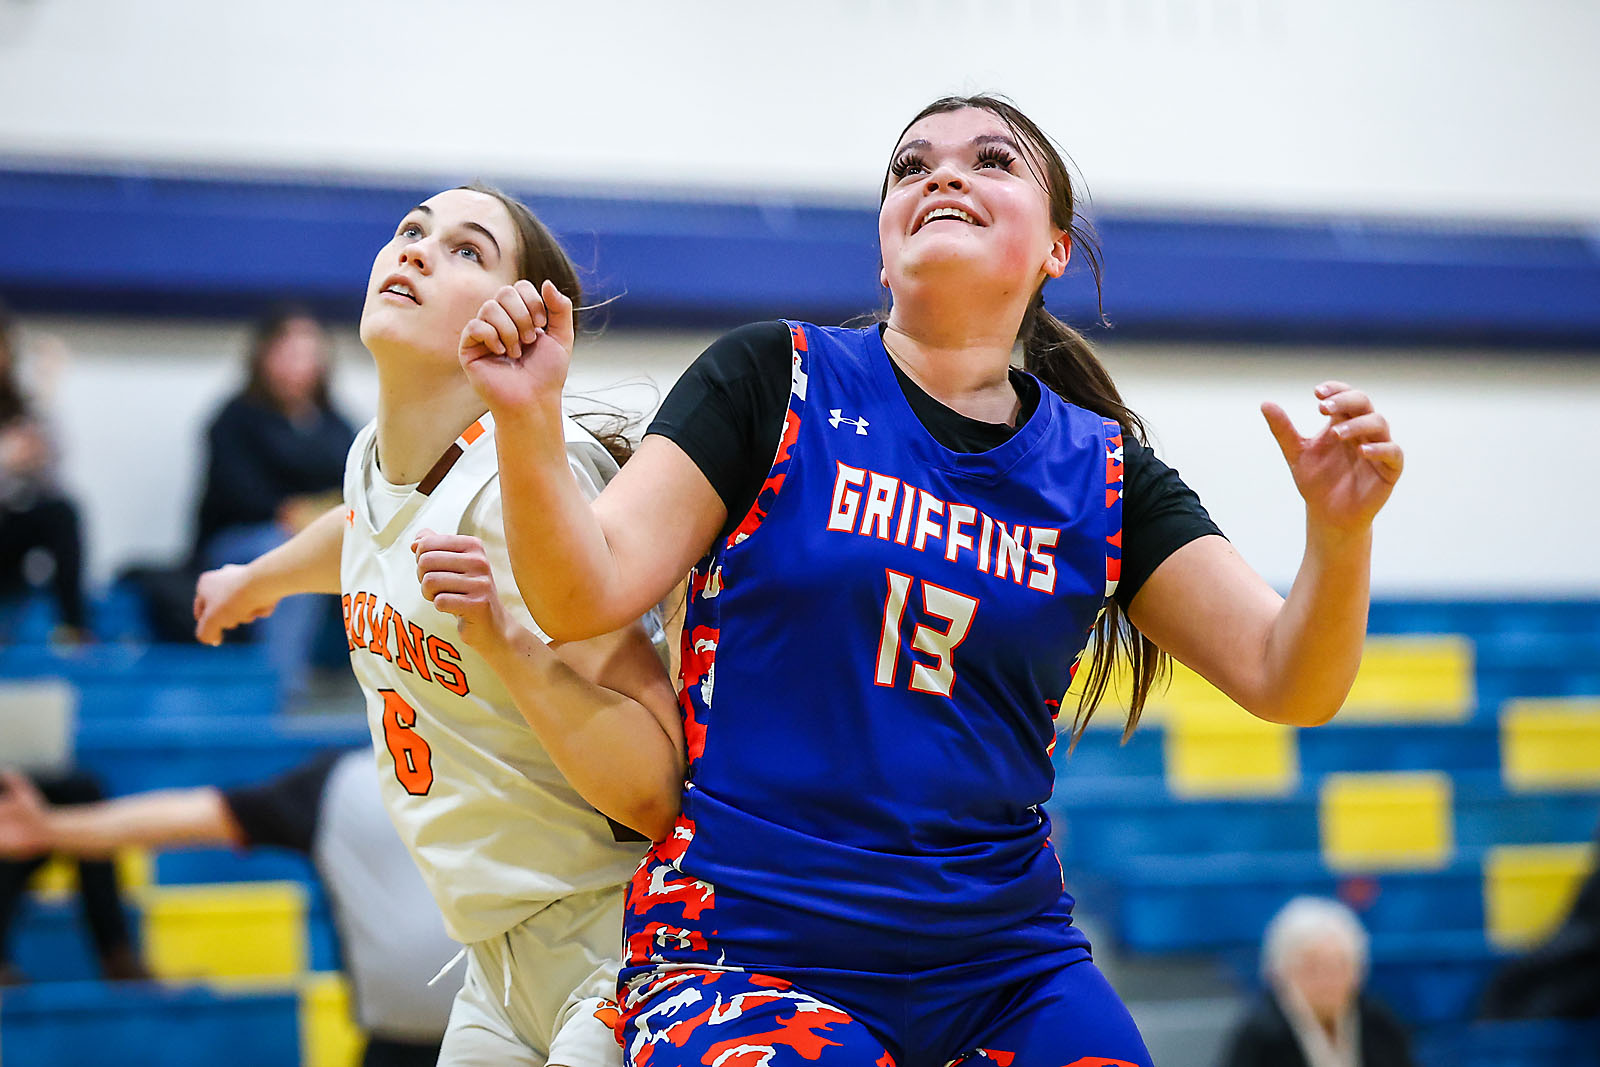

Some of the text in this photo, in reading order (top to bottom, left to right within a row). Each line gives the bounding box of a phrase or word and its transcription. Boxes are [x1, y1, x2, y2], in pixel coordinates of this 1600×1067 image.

[826, 459, 1061, 595] GRIFFINS
[874, 568, 980, 699] 13
[377, 688, 434, 796] 6
